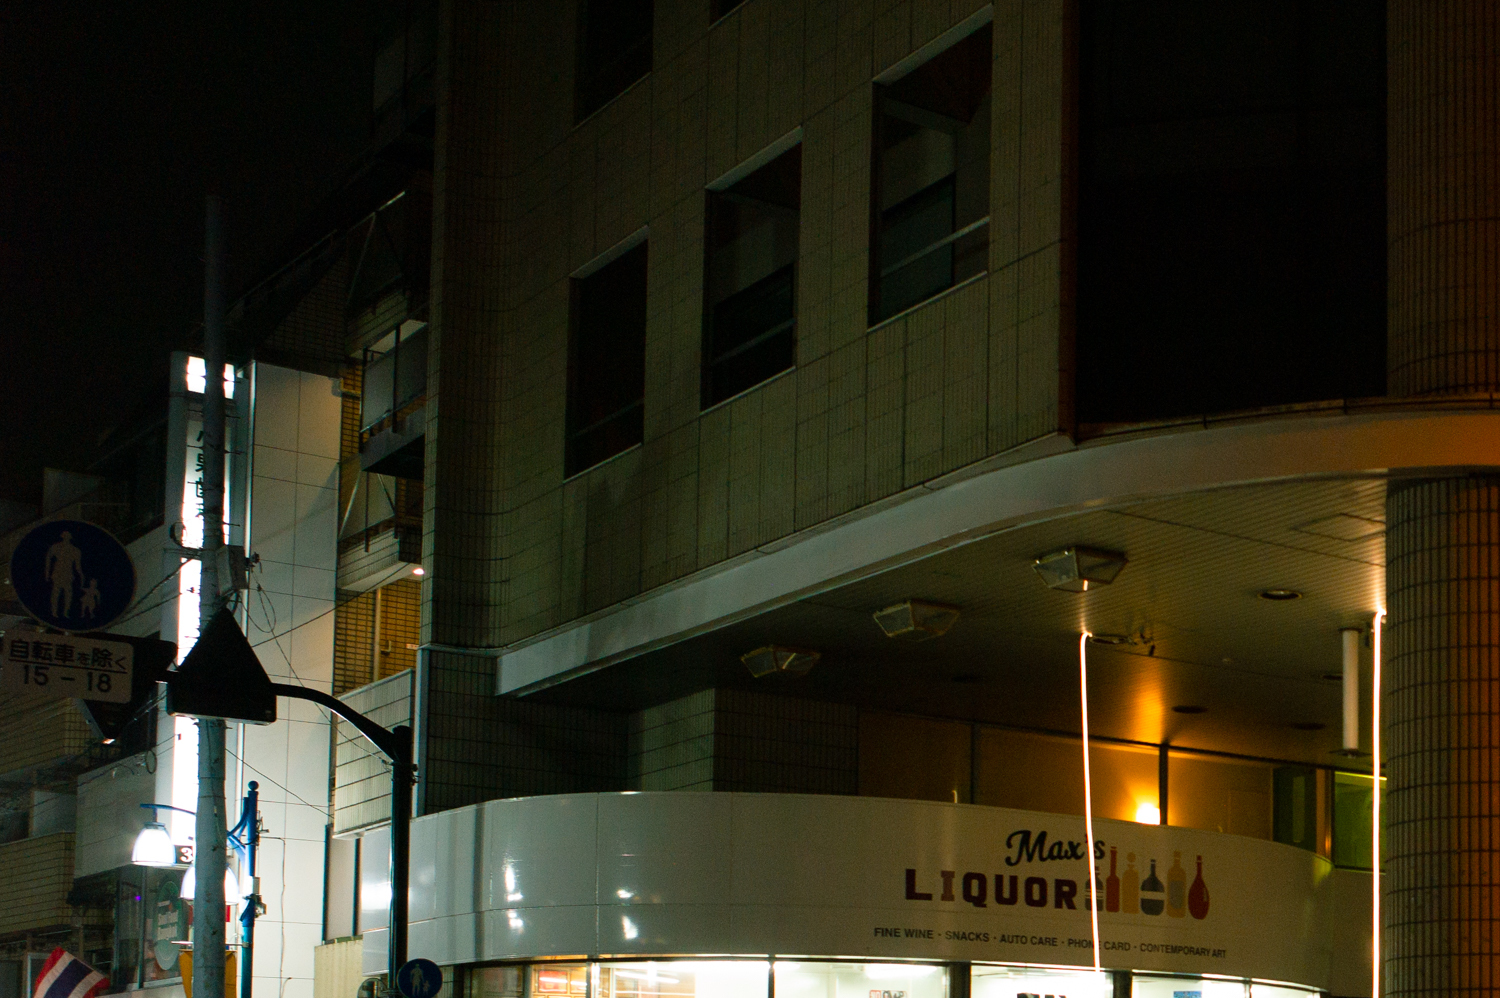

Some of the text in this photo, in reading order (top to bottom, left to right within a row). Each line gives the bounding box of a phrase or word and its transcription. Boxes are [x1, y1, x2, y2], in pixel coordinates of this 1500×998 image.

[10, 638, 127, 670] 自転車を除く
[1005, 829, 1106, 867] Max's
[905, 868, 1077, 910] LIQUOR
[874, 927, 901, 938] FINE
[904, 928, 934, 939] WINE
[945, 930, 990, 942] SNACKS
[1000, 934, 1028, 945] AUTO
[1029, 936, 1058, 947] CARE
[1103, 940, 1131, 951] CARD
[1139, 943, 1210, 957] CONTEMPORARY
[1211, 949, 1226, 959] ART
